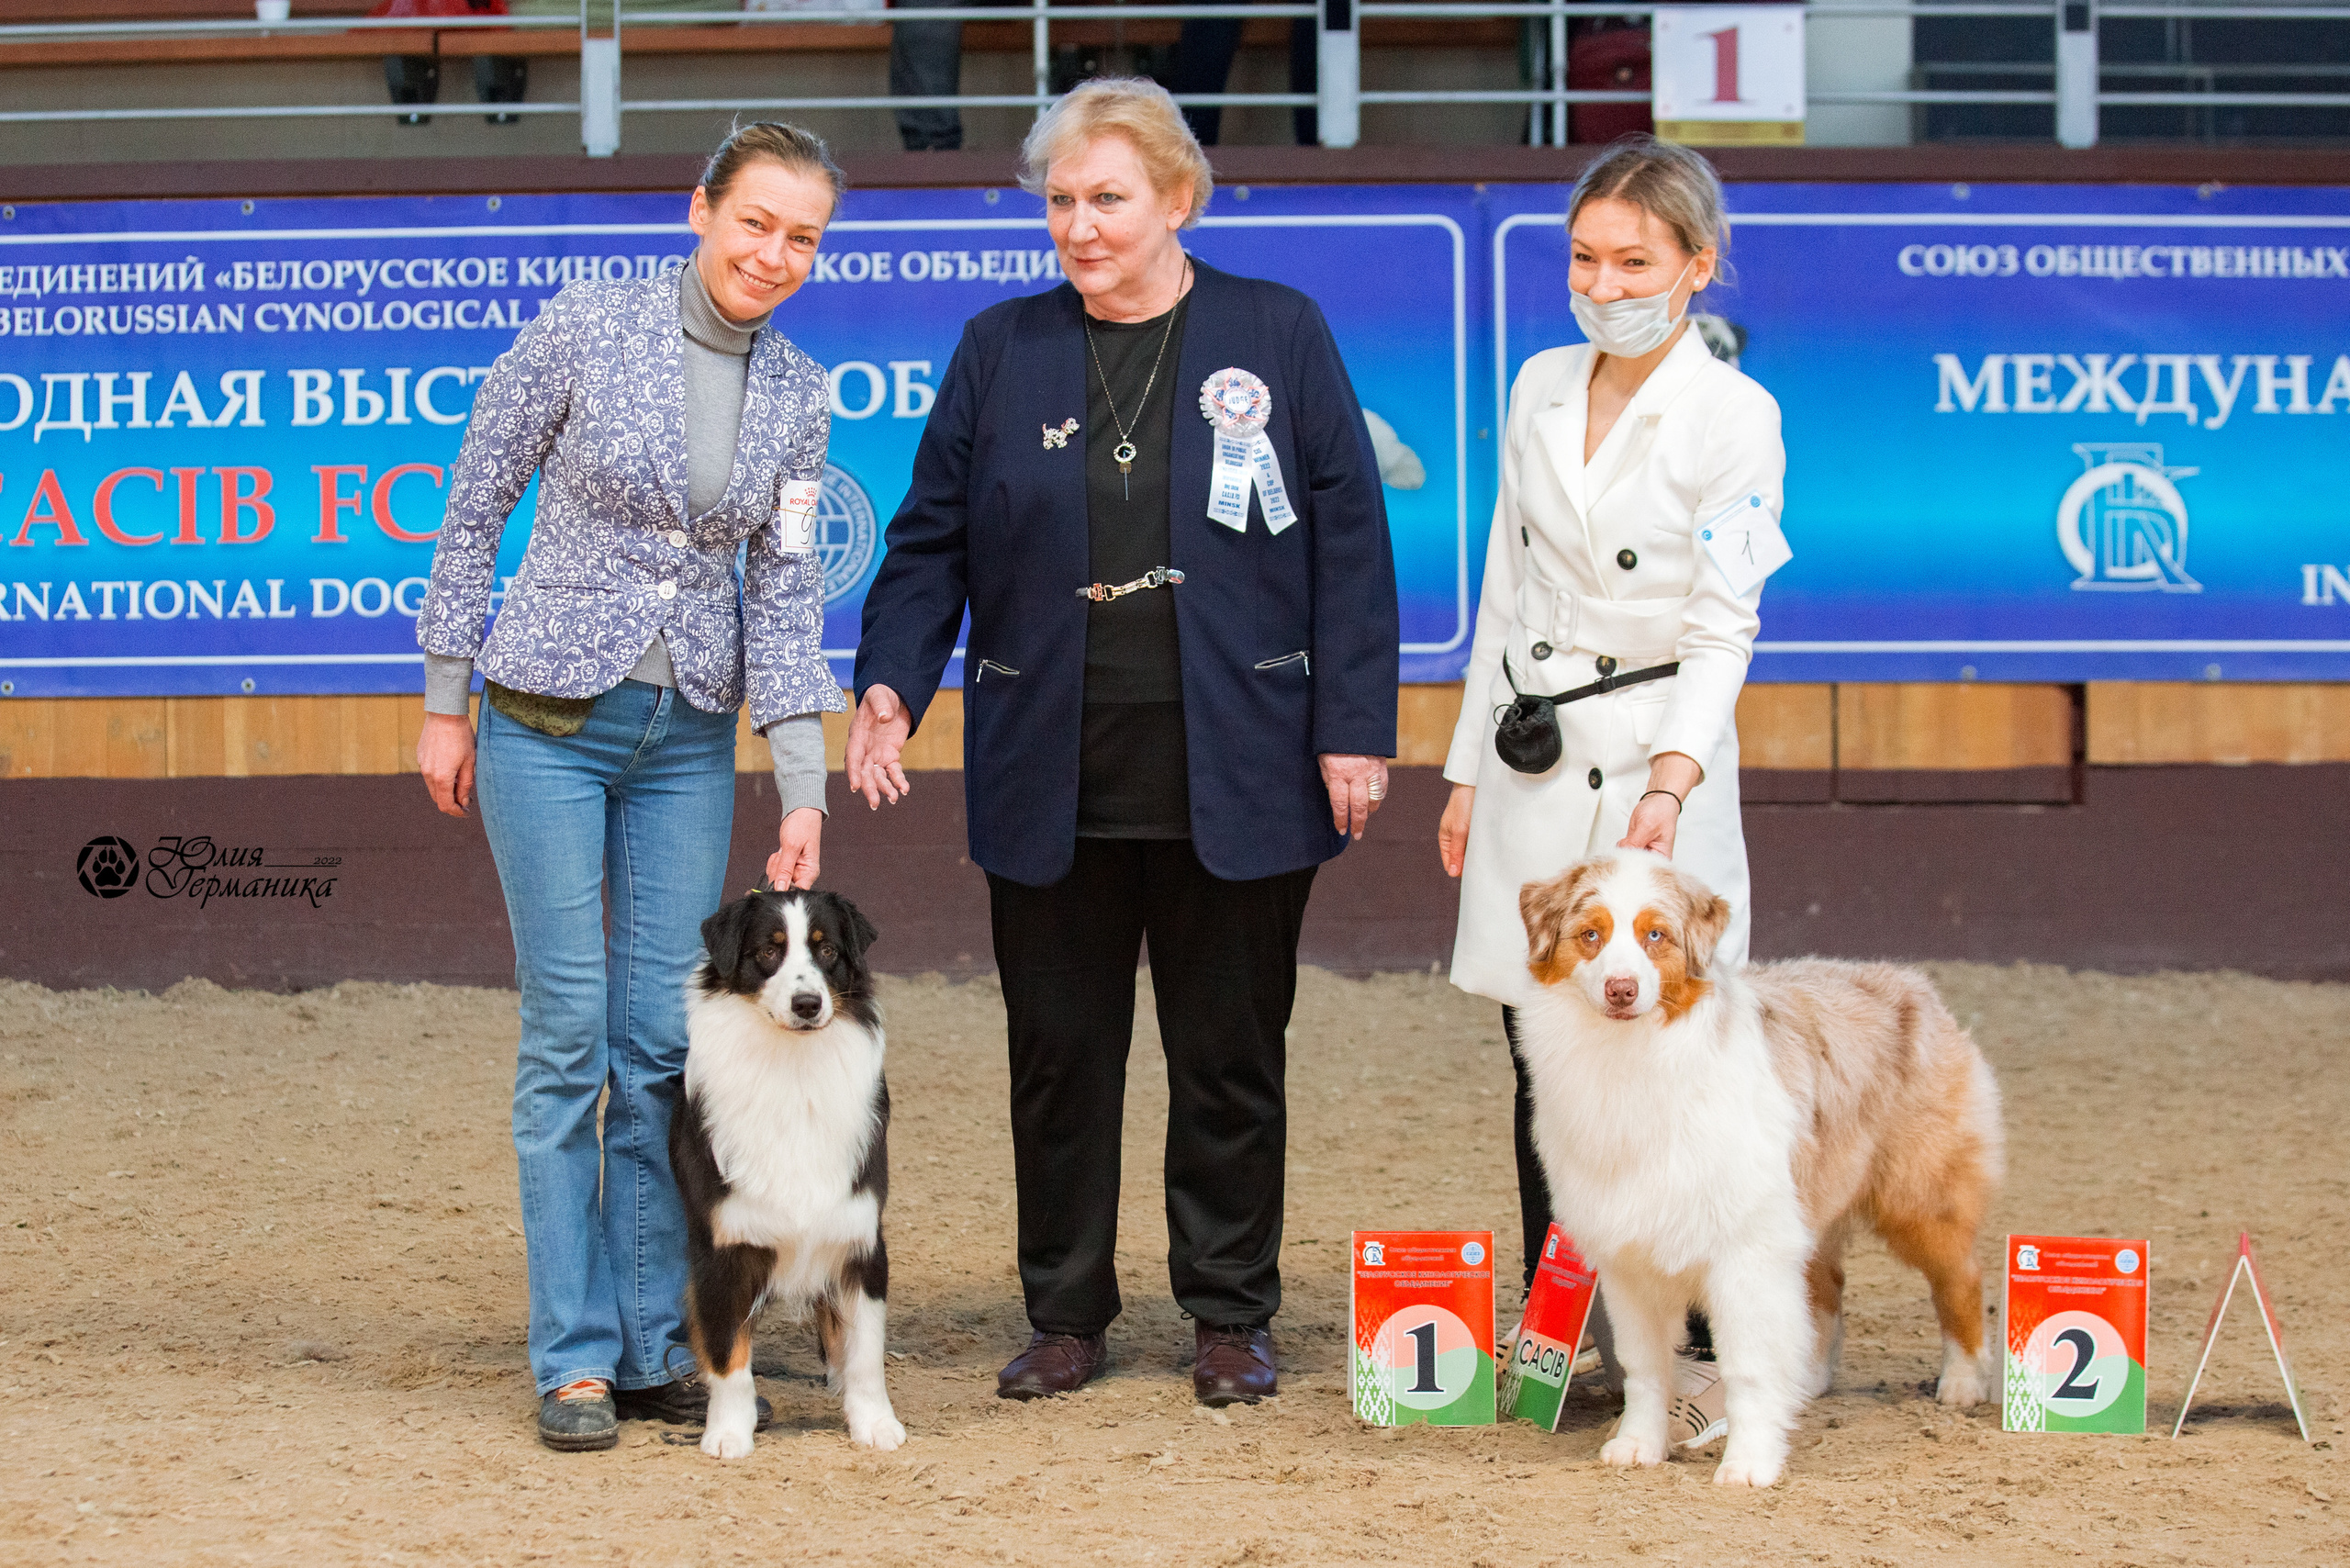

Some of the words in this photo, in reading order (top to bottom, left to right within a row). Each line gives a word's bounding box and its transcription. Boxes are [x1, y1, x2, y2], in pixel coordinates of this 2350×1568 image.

[1696, 27, 1754, 103] 1
[215, 257, 509, 296] «БЕЛОРУССКОЕ
[899, 250, 1068, 286] ОБЪЕДИ
[1897, 243, 2020, 277] СОЮЗ
[2024, 243, 2350, 282] ОБЩЕСТВЕННЫХ
[253, 298, 531, 333] CYNOLOGICAL
[292, 366, 489, 427] ВЫС
[1932, 353, 2350, 430] МЕЖДУНА
[0, 465, 275, 547] ACIB
[310, 462, 459, 543] FC
[789, 498, 810, 506] ROYAL
[1218, 500, 1241, 509] MINSK
[1269, 505, 1285, 513] MINSK
[309, 577, 431, 618] DOG
[1404, 1321, 1446, 1394] 1
[1518, 1338, 1566, 1379] CACIB
[2050, 1327, 2102, 1401] 2
